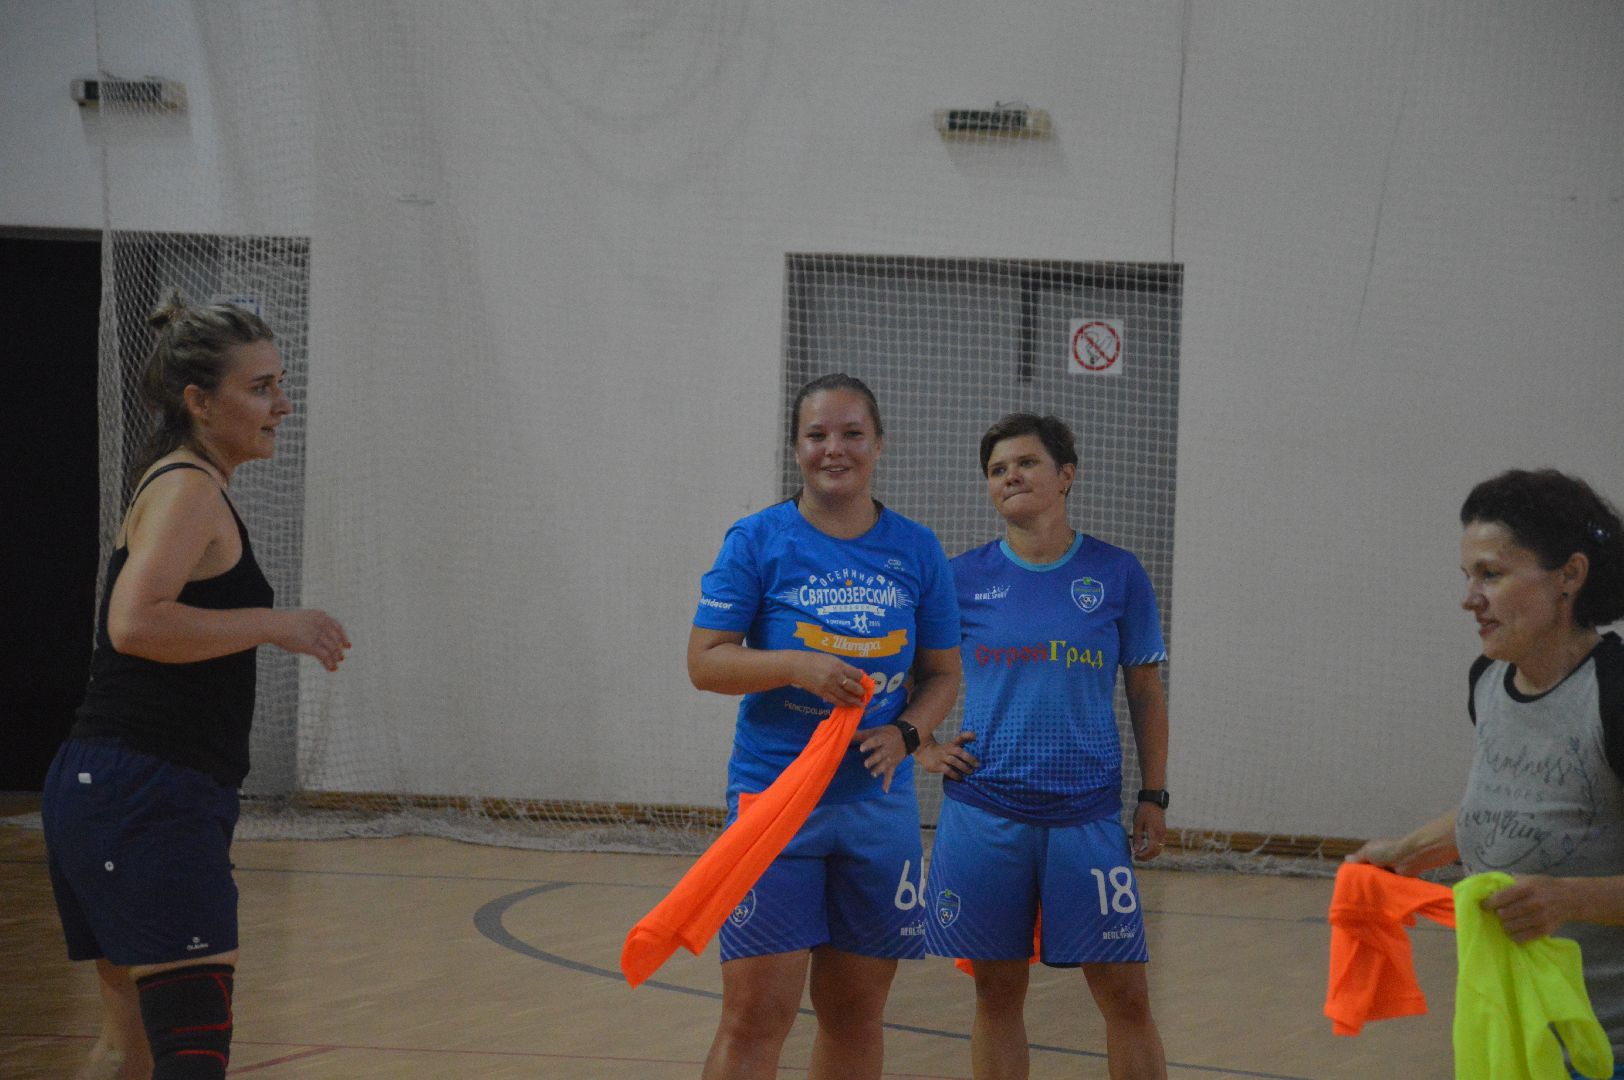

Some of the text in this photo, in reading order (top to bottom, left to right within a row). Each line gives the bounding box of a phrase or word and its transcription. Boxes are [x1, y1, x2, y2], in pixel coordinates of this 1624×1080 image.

[819, 567, 875, 586] ОСЕННИЙ
[799, 581, 897, 608] СВЯТООЗЕРСКИЙ
[1090, 865, 1137, 915] 18
